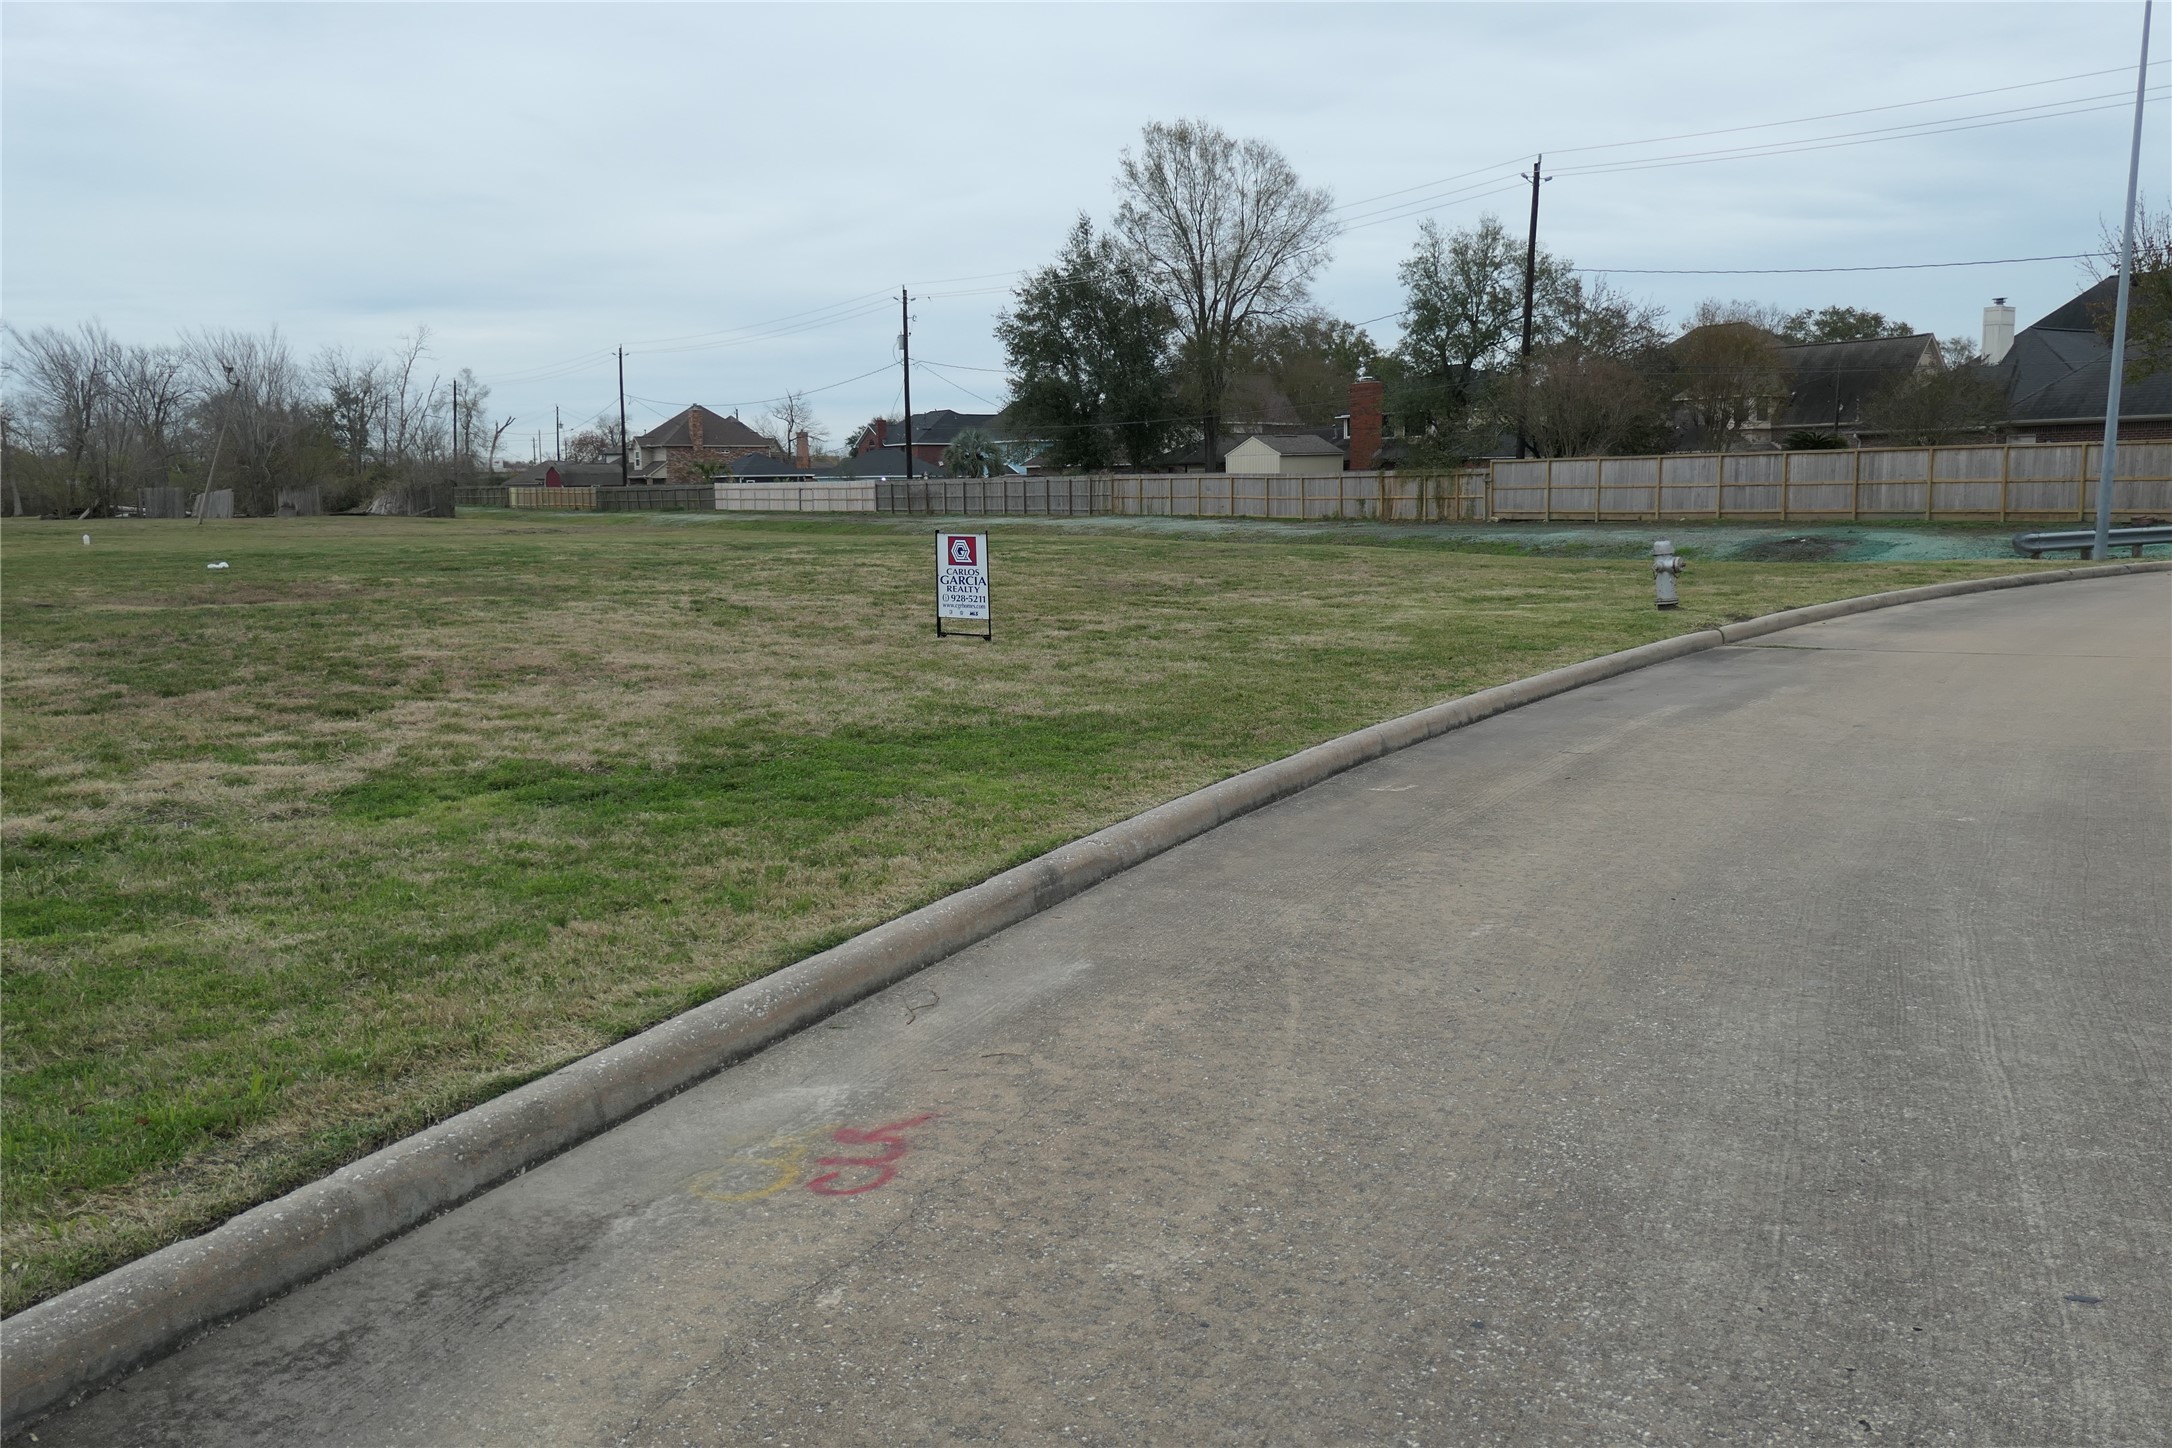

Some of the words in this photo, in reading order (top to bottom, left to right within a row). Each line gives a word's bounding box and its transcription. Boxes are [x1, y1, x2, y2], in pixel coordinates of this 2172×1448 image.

[946, 568, 980, 576] CARLOS
[940, 575, 987, 586] GARCIA
[946, 585, 980, 593] REALTY
[950, 594, 986, 603] 928-5211
